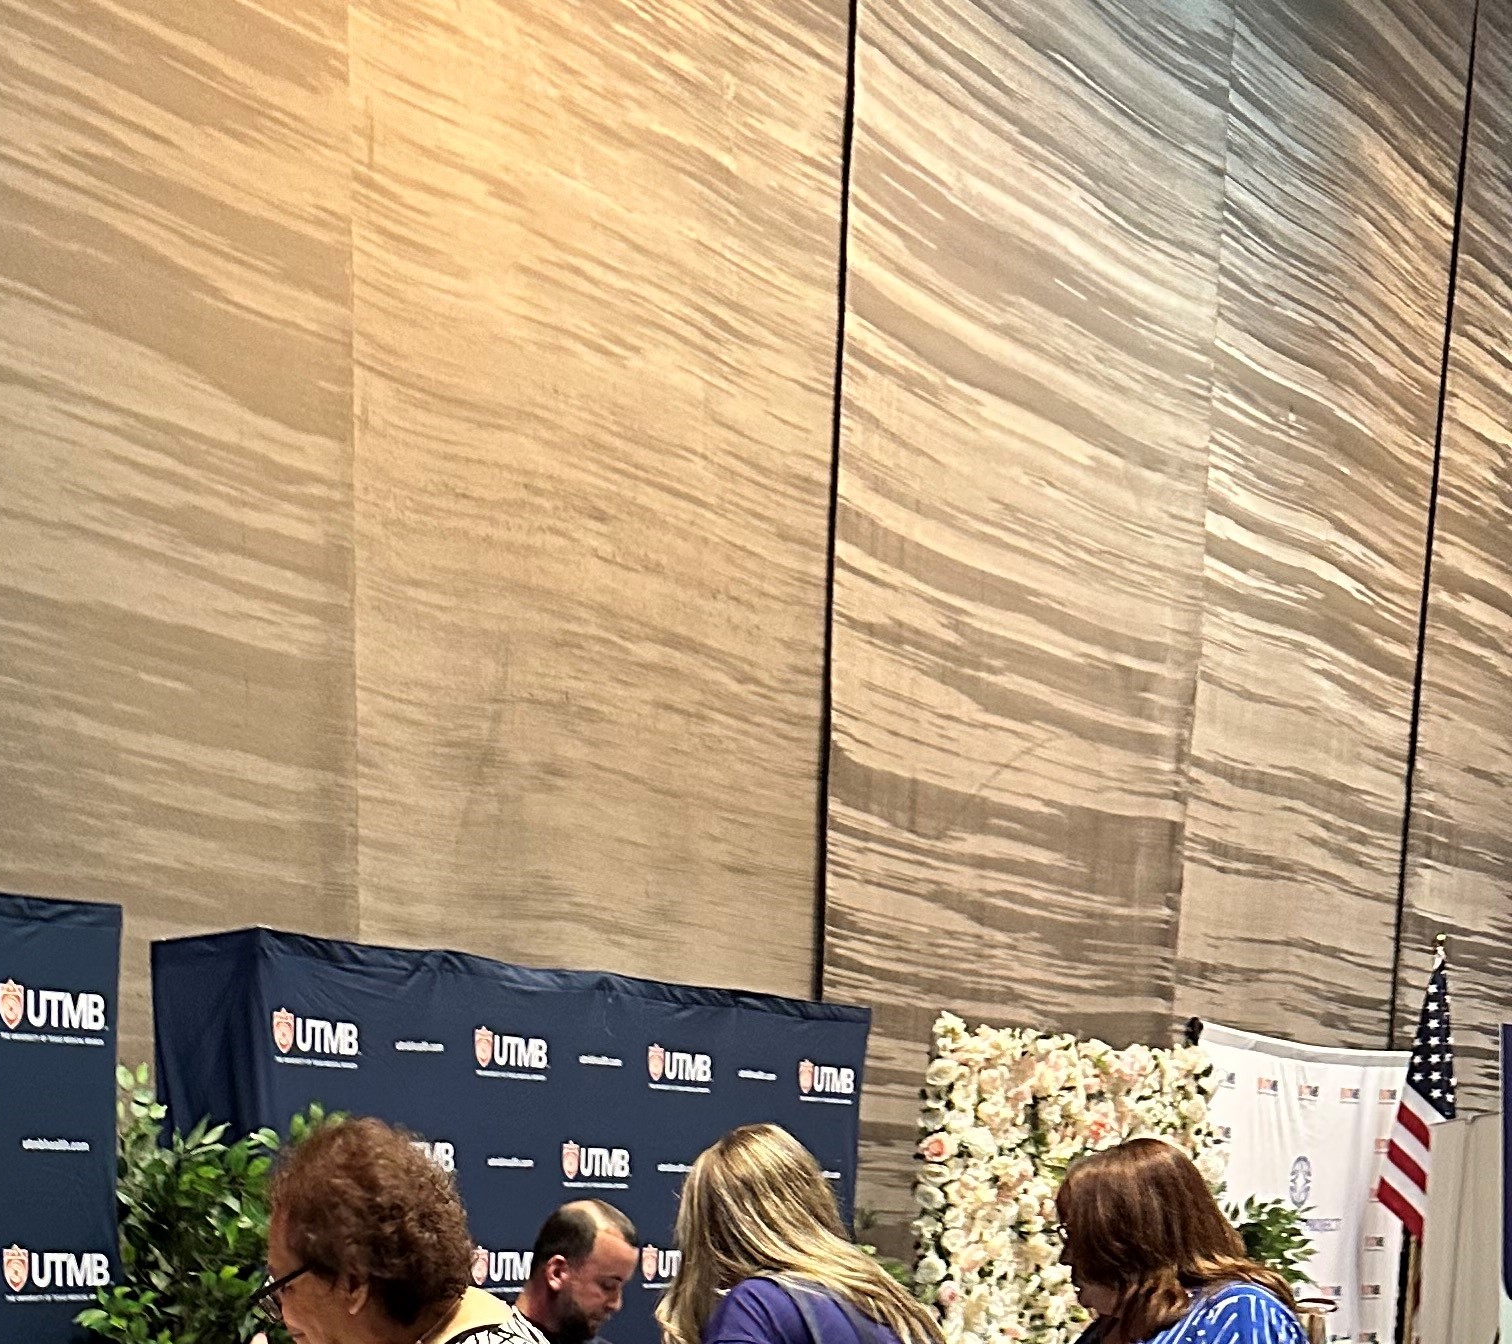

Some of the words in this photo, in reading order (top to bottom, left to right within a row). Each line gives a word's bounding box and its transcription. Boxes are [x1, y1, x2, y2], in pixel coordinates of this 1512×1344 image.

[27, 989, 105, 1031] UTMB
[296, 1017, 358, 1056] UTMB
[494, 1034, 547, 1068] UTMB
[665, 1051, 711, 1082] UTMB
[580, 1149, 629, 1178] UTMB
[31, 1252, 110, 1287] UTMB
[489, 1251, 534, 1281] UTM
